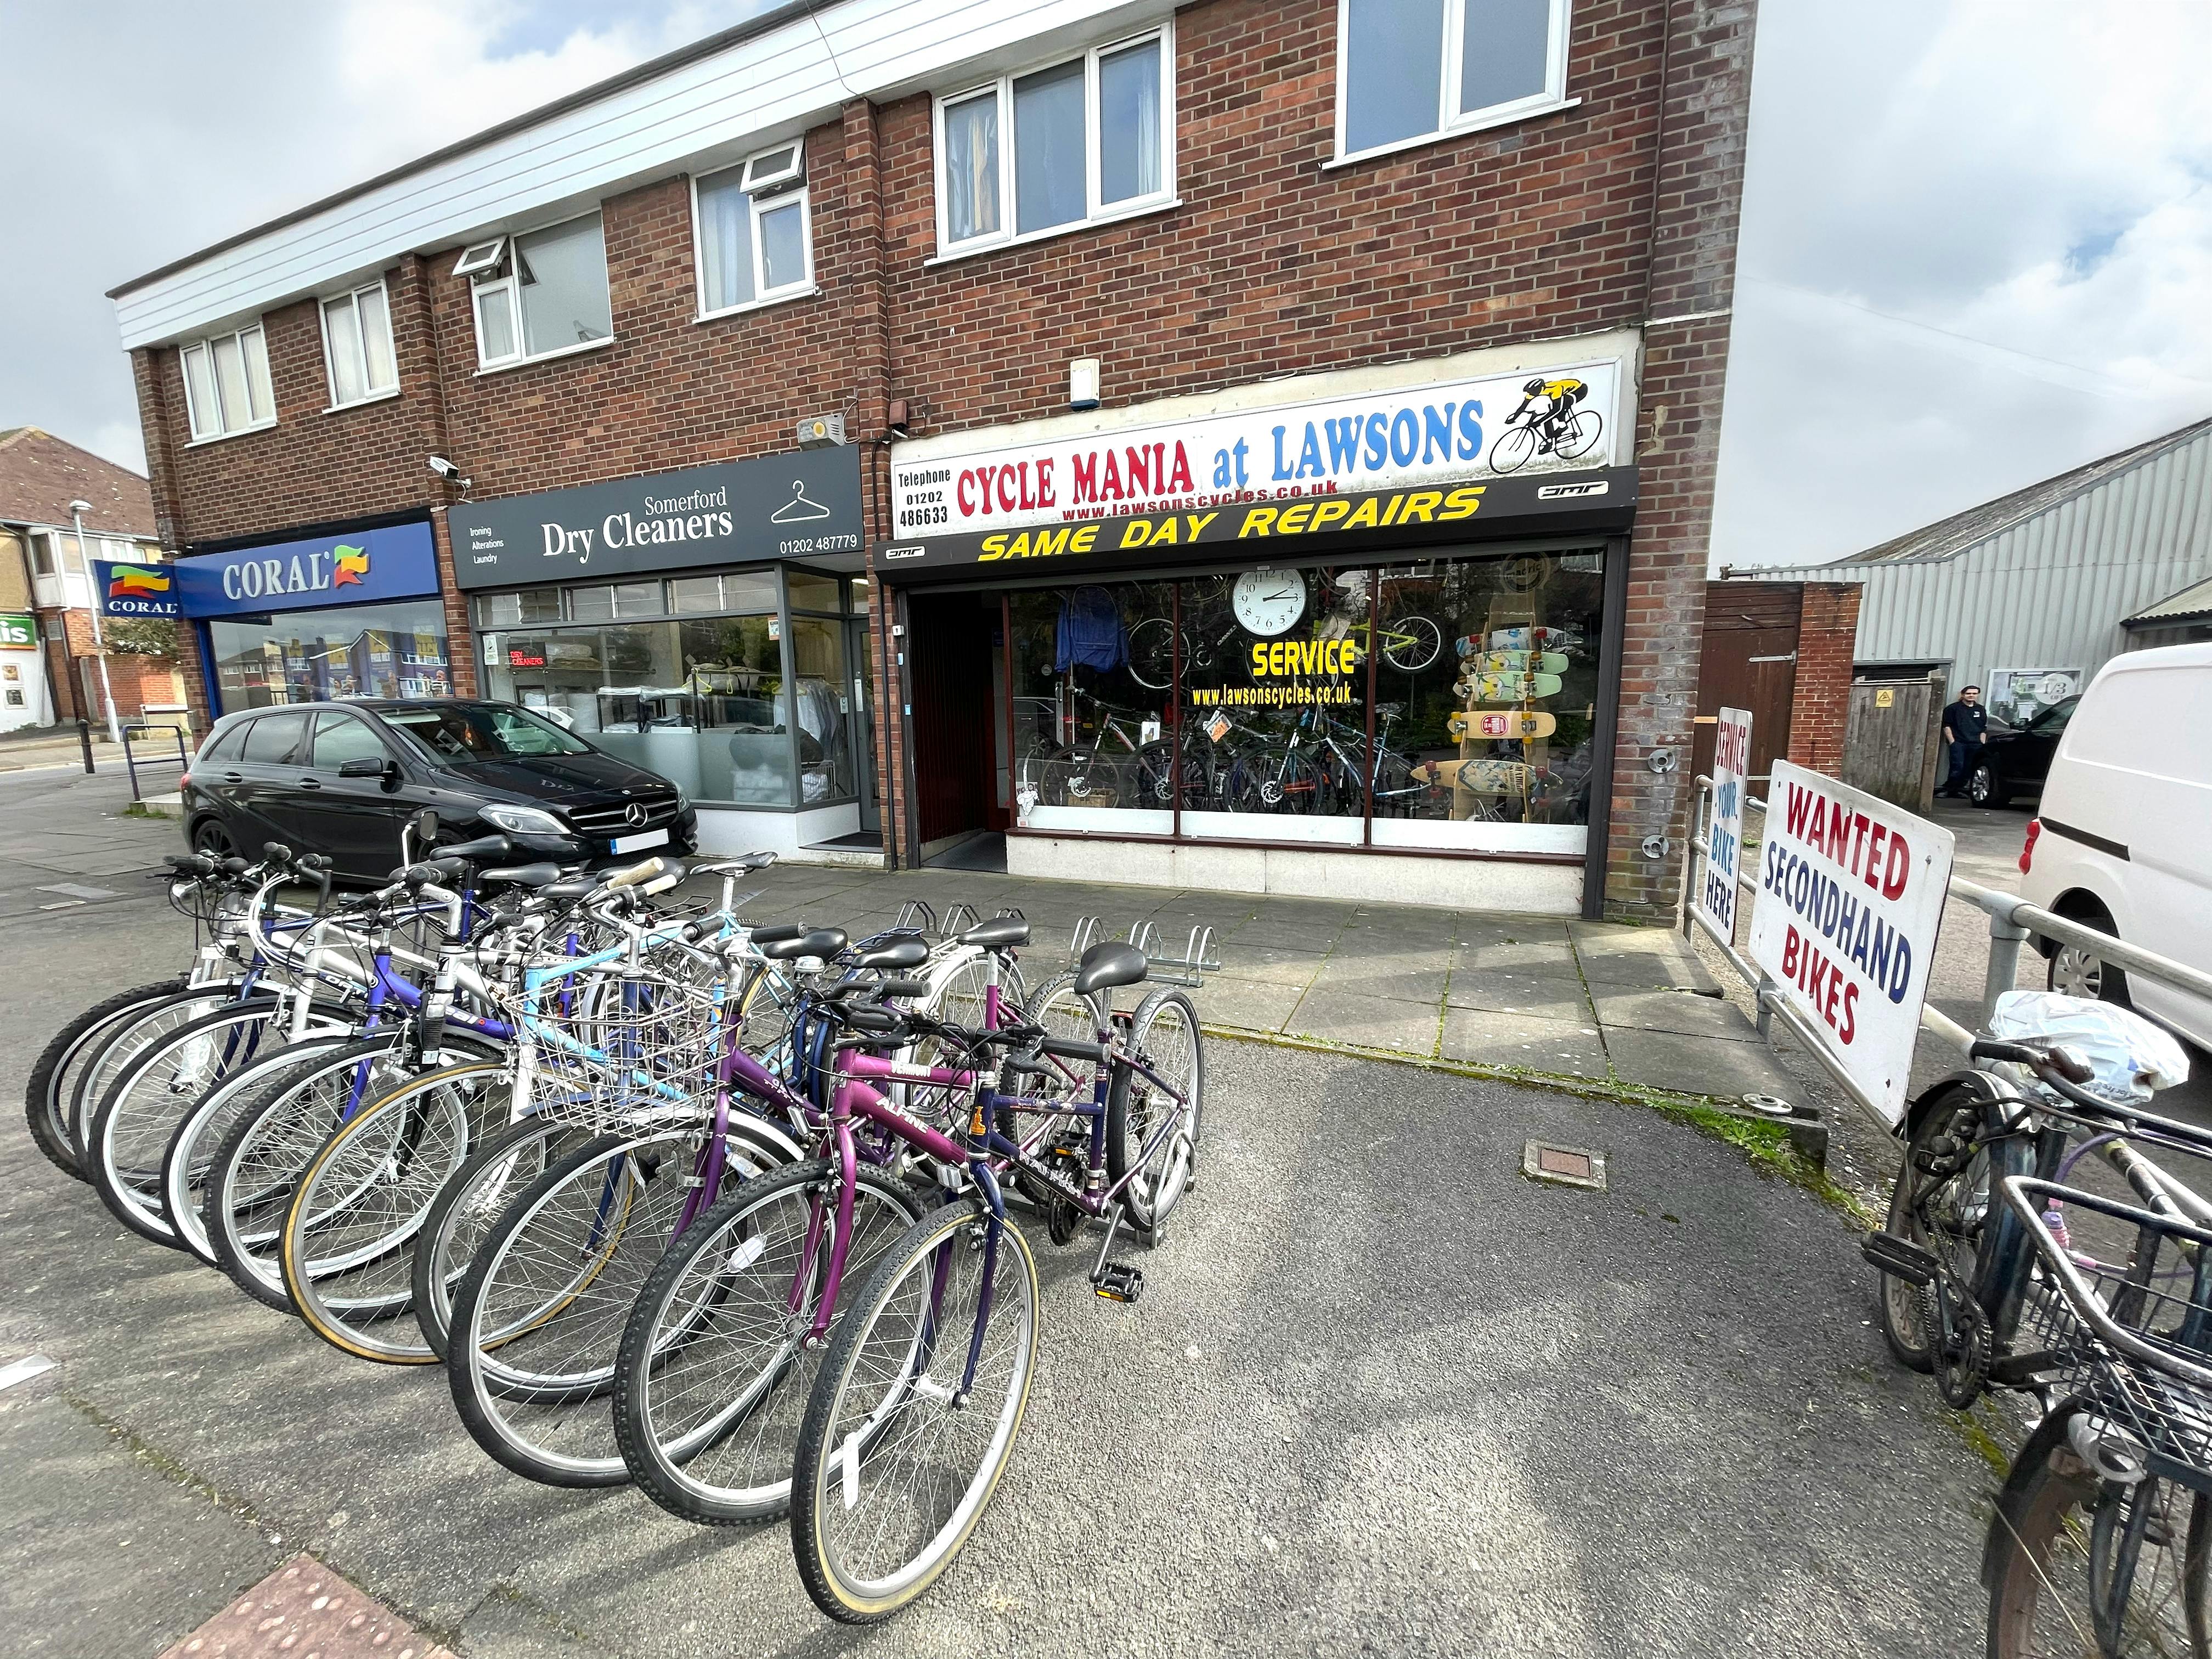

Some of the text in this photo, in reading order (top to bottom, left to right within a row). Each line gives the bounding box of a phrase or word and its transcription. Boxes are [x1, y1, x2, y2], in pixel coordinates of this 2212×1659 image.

[957, 399, 1483, 517] CYCLE MANIA at LAWSONS
[899, 470, 950, 487] Telephone
[645, 486, 726, 516] Somerford
[906, 491, 943, 505] 01202
[1062, 479, 1338, 521] www.lawsonscycles.co.uk
[900, 506, 947, 527] 486633
[978, 486, 1487, 562] SAME DAY REPAIRS
[470, 526, 492, 537] Ironing
[541, 511, 733, 564] Dry Cleaners
[472, 539, 504, 550] Alterations
[780, 534, 857, 554] 01202 487779
[473, 553, 498, 564] Laundry
[223, 554, 329, 600] CORAL
[1255, 574, 1262, 582] 11
[1282, 572, 1284, 580] 1
[1288, 580, 1294, 589] 2
[1246, 584, 1255, 592] 10
[1242, 595, 1248, 603] 9
[1292, 593, 1298, 602] 3
[109, 601, 177, 614] CORAL
[1245, 607, 1251, 616] 8
[1255, 616, 1261, 624] 7
[1266, 618, 1272, 628] 6
[1279, 615, 1285, 623] 5
[512, 657, 544, 665] CLEANERS
[1252, 639, 1356, 676] SERVICE
[1193, 681, 1351, 710] www.lawsonscycles.co.uk
[1717, 720, 1746, 776] SERVICE
[1718, 781, 1736, 819] YOUR
[1711, 823, 1735, 877] BIKE
[1787, 782, 1910, 901] WANTED
[1706, 869, 1733, 930] HERE
[1764, 840, 1912, 1005] SECONDHAND
[1782, 923, 1859, 1045] BIKES
[890, 1060, 931, 1077] VERMONT
[876, 1097, 929, 1134] ALPINE
